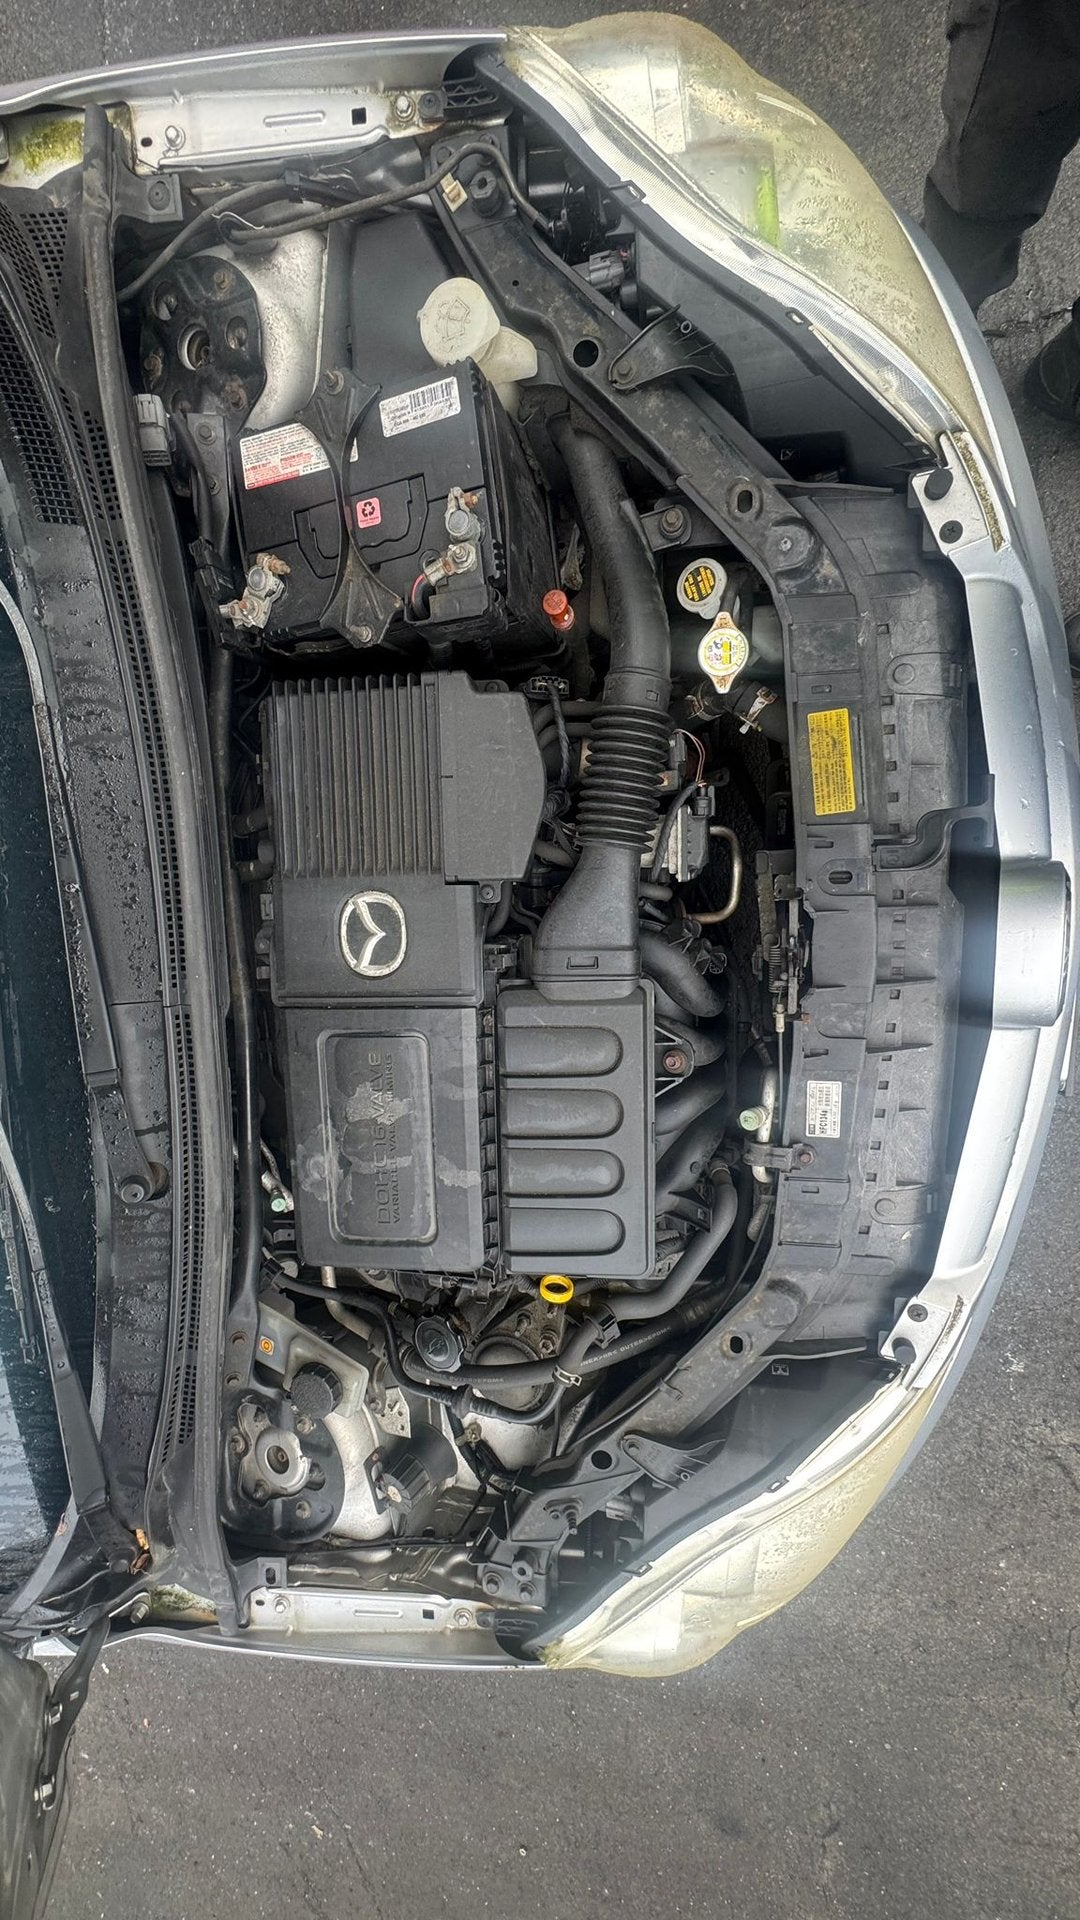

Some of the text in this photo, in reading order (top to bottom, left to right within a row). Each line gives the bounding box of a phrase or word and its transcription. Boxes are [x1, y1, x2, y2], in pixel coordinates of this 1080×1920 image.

[368, 1053, 391, 1224] DOHC 16 VALVE
[390, 1156, 401, 1224] VARIABLE
